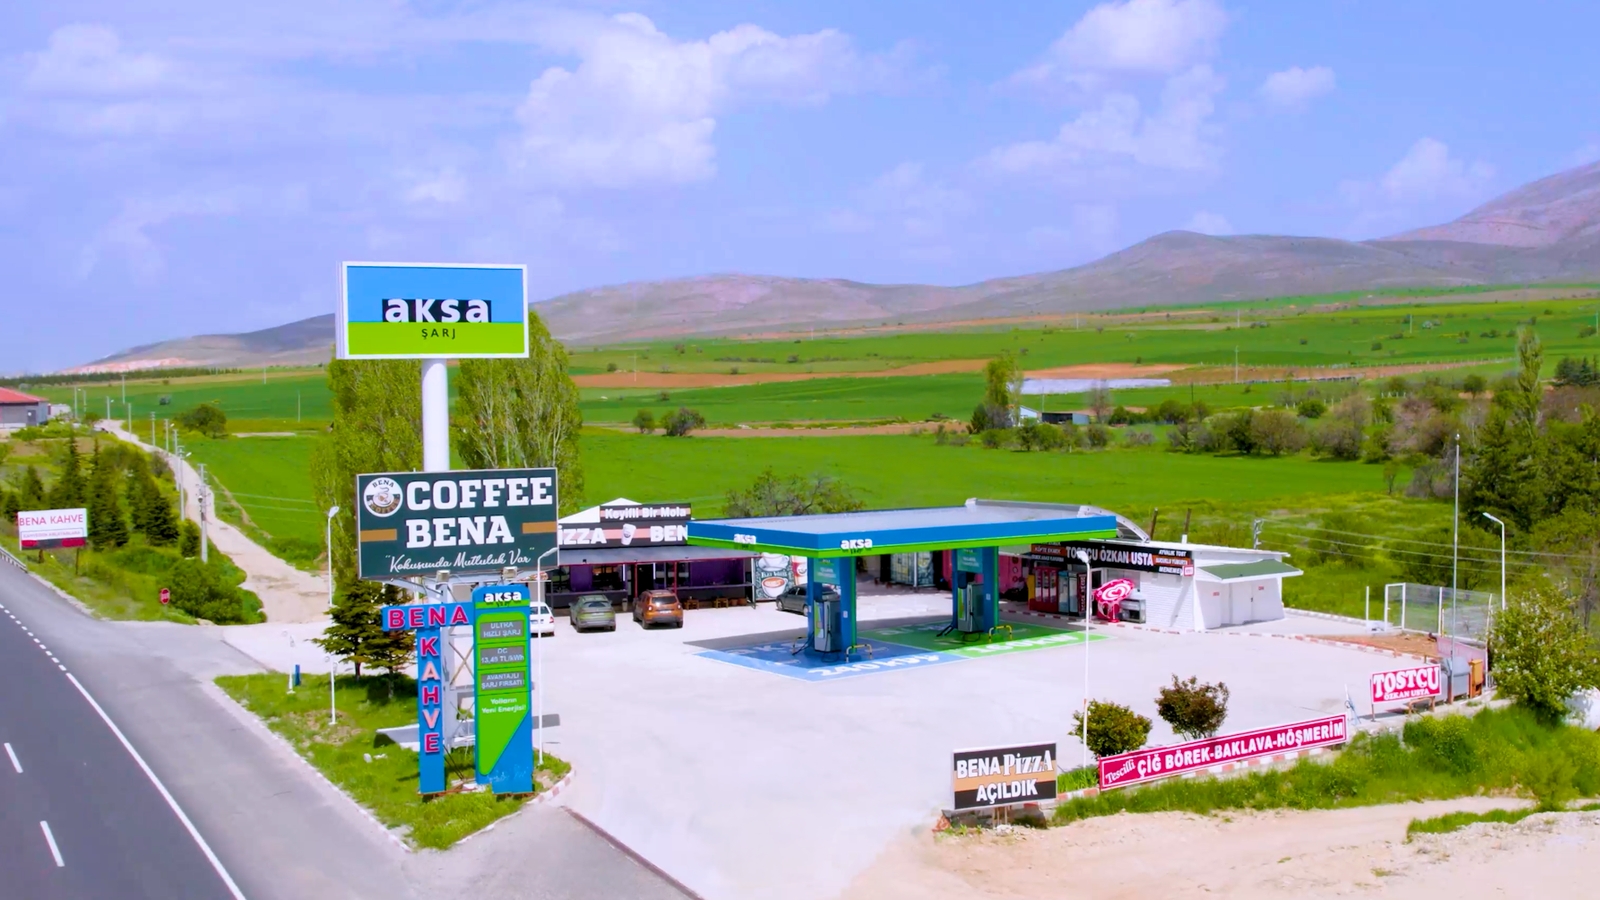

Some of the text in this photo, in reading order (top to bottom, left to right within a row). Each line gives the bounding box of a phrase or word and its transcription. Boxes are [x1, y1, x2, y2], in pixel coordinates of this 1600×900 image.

[385, 298, 489, 323] aksa
[421, 328, 456, 340] ŞARJ
[372, 480, 395, 489] BENA
[406, 477, 553, 511] COFFEE
[19, 514, 83, 527] BENA KAHVE
[605, 507, 687, 520] Keyifli Bir Mola
[406, 515, 514, 549] BENA
[558, 525, 688, 545] İZZA BEN
[840, 538, 873, 550] aksa
[454, 552, 507, 568] Mutluluk
[1100, 545, 1129, 564] ÖZKAN
[1130, 552, 1154, 568] USTA
[484, 591, 522, 604] aksa
[388, 606, 468, 629] BENA
[497, 647, 508, 655] DC
[420, 637, 441, 755] KAHVE
[1384, 688, 1430, 701] ÖZKAN USTA
[1105, 720, 1343, 785] Tescilli ÇİĞ BÖREK-BAKLAVA-HÖŞMERİM
[956, 756, 1001, 780] BENA
[976, 779, 1039, 805] AÇILDIK
